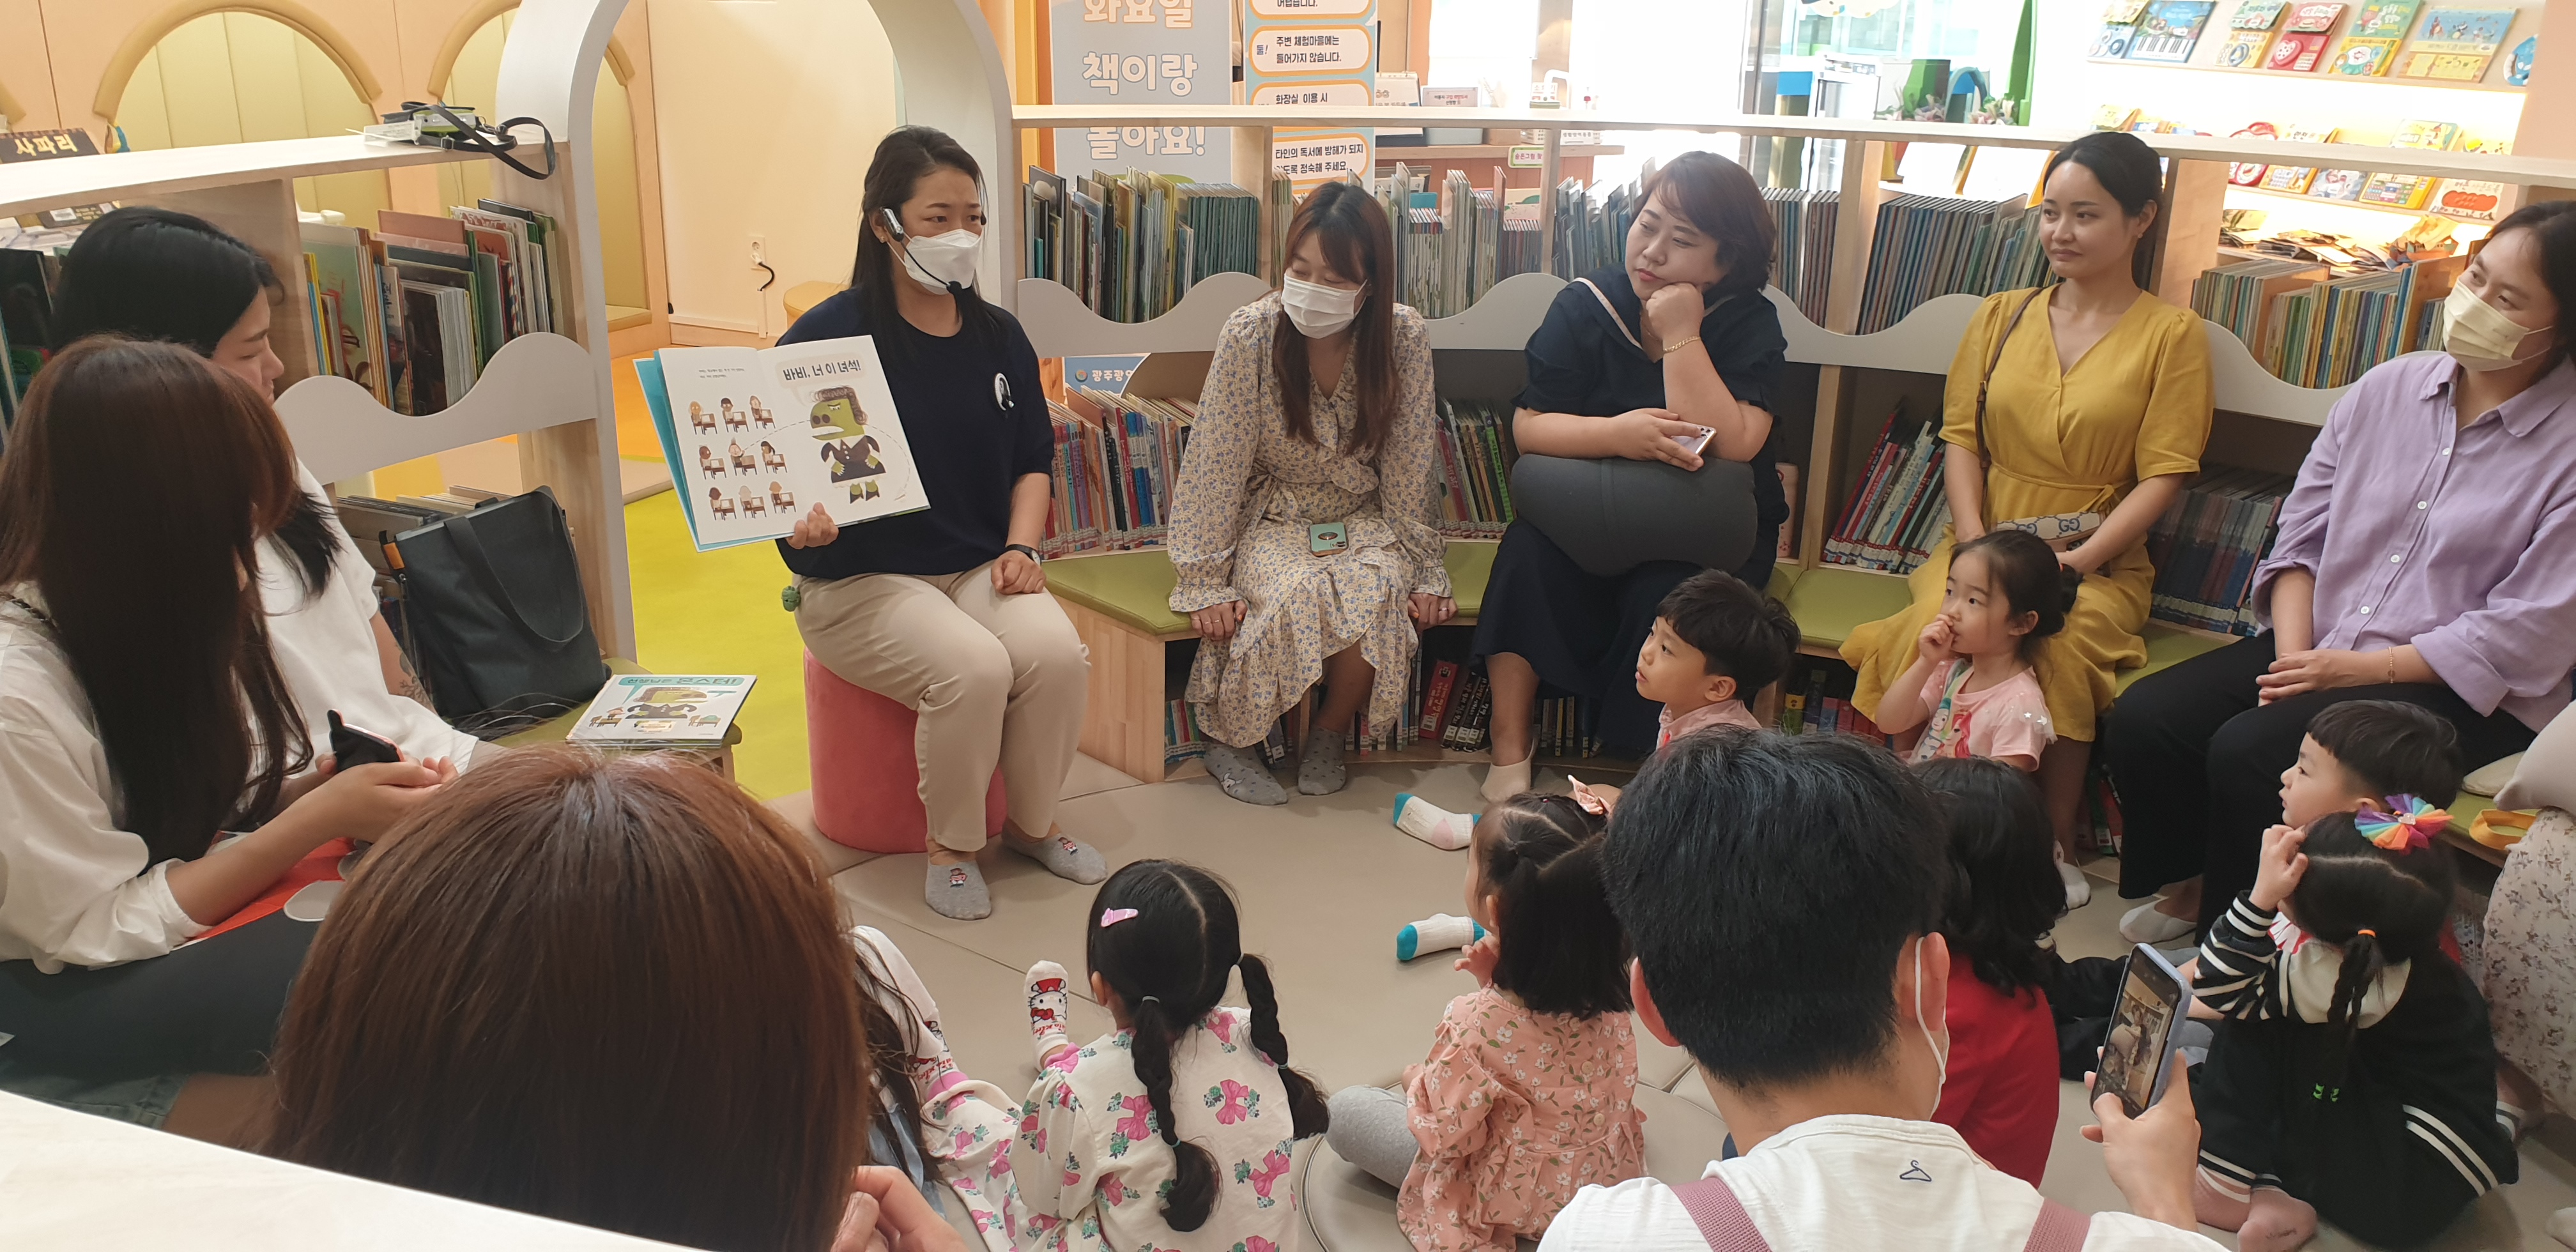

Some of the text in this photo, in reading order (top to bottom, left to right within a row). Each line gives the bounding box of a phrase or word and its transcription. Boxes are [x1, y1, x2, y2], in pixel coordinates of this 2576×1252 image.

[1084, 0, 1193, 29] 화요일
[1276, 35, 1340, 47] 주변 체험마을에는
[1256, 44, 1269, 56] 둘!
[1276, 52, 1342, 64] 들어가지 않습니다.
[1082, 51, 1199, 96] 책이랑
[1275, 92, 1328, 105] 화장실 이용 시
[14, 134, 79, 156] 사파리
[1275, 143, 1363, 159] 타인의 독서에 방해가 되지
[1274, 164, 1298, 175] 도록
[1300, 162, 1322, 174] 정숙해
[783, 360, 861, 381] 바비, 너 이 녀석!
